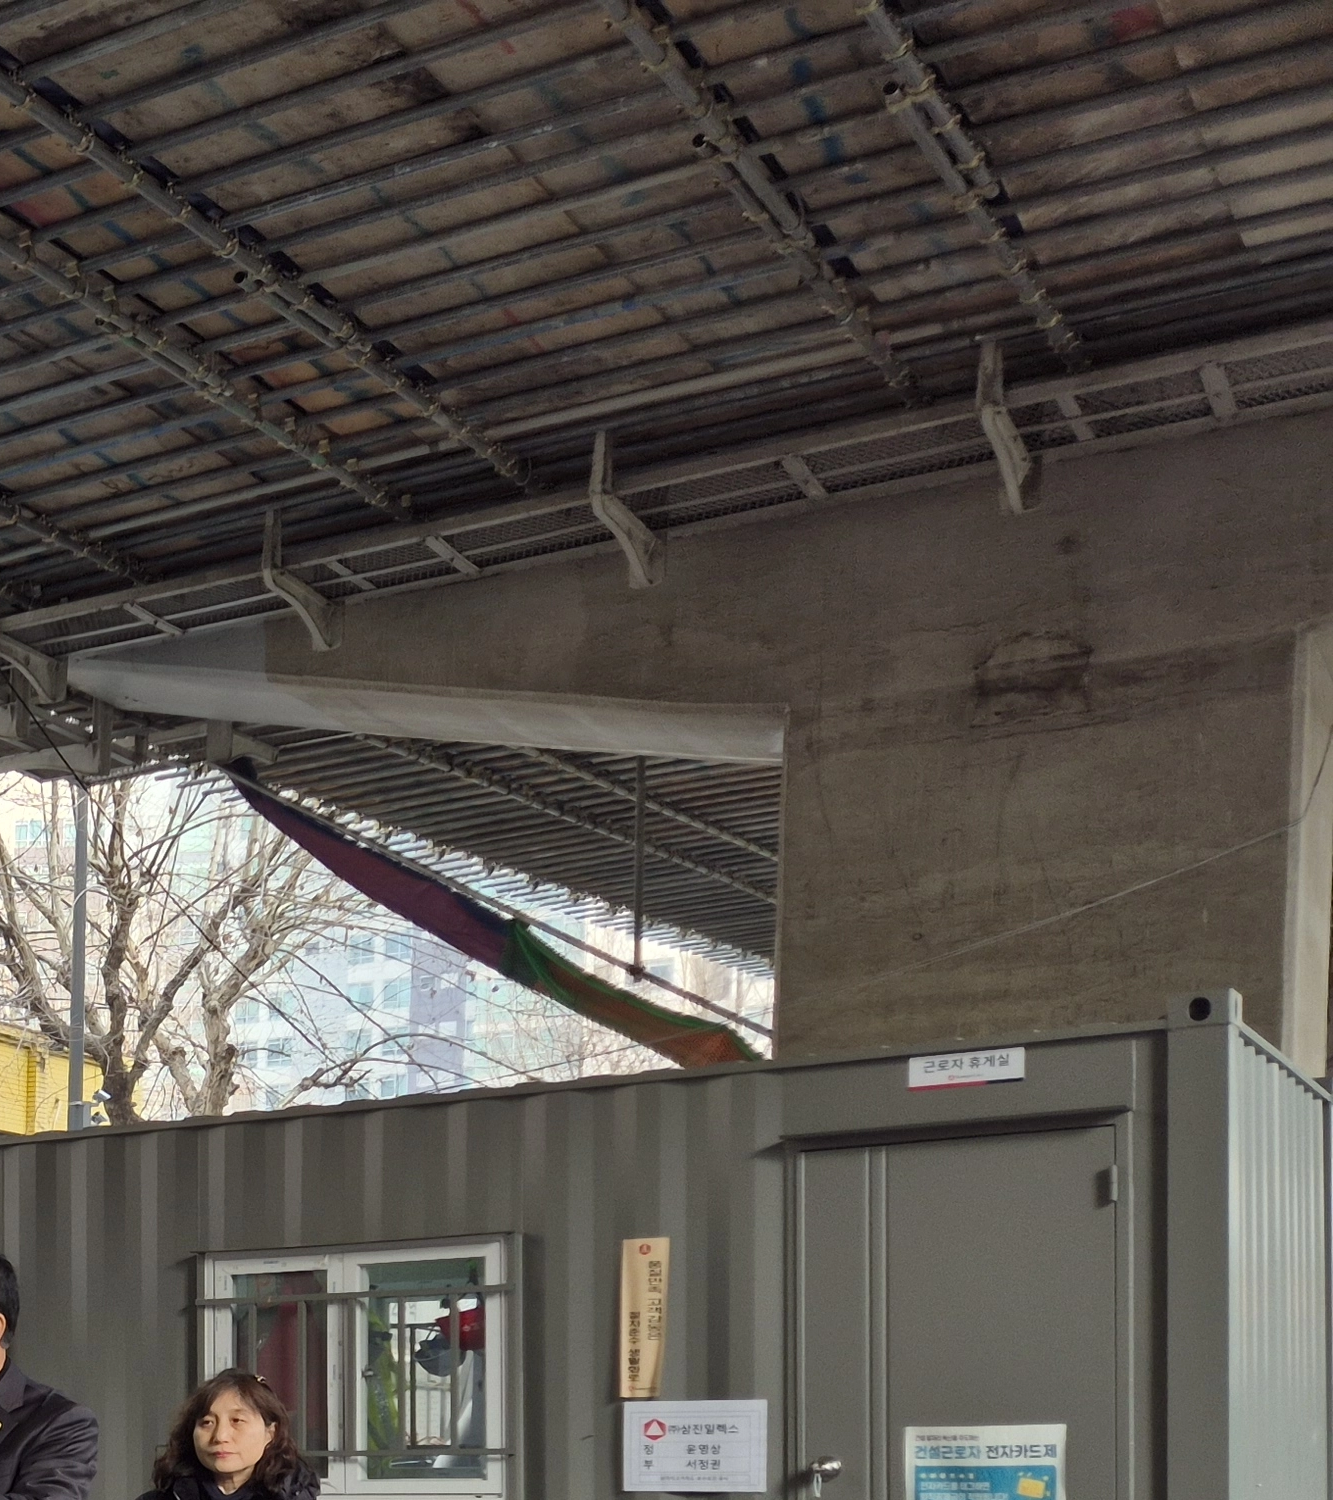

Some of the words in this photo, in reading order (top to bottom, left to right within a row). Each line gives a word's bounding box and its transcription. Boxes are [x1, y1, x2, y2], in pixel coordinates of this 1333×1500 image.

[923, 1058, 963, 1074] 근로자
[969, 1053, 1010, 1068] 휴게실
[644, 1444, 654, 1455] 정
[914, 1445, 981, 1460] 건설근로자
[985, 1444, 1057, 1459] 전자카드제
[644, 1460, 654, 1470] 부
